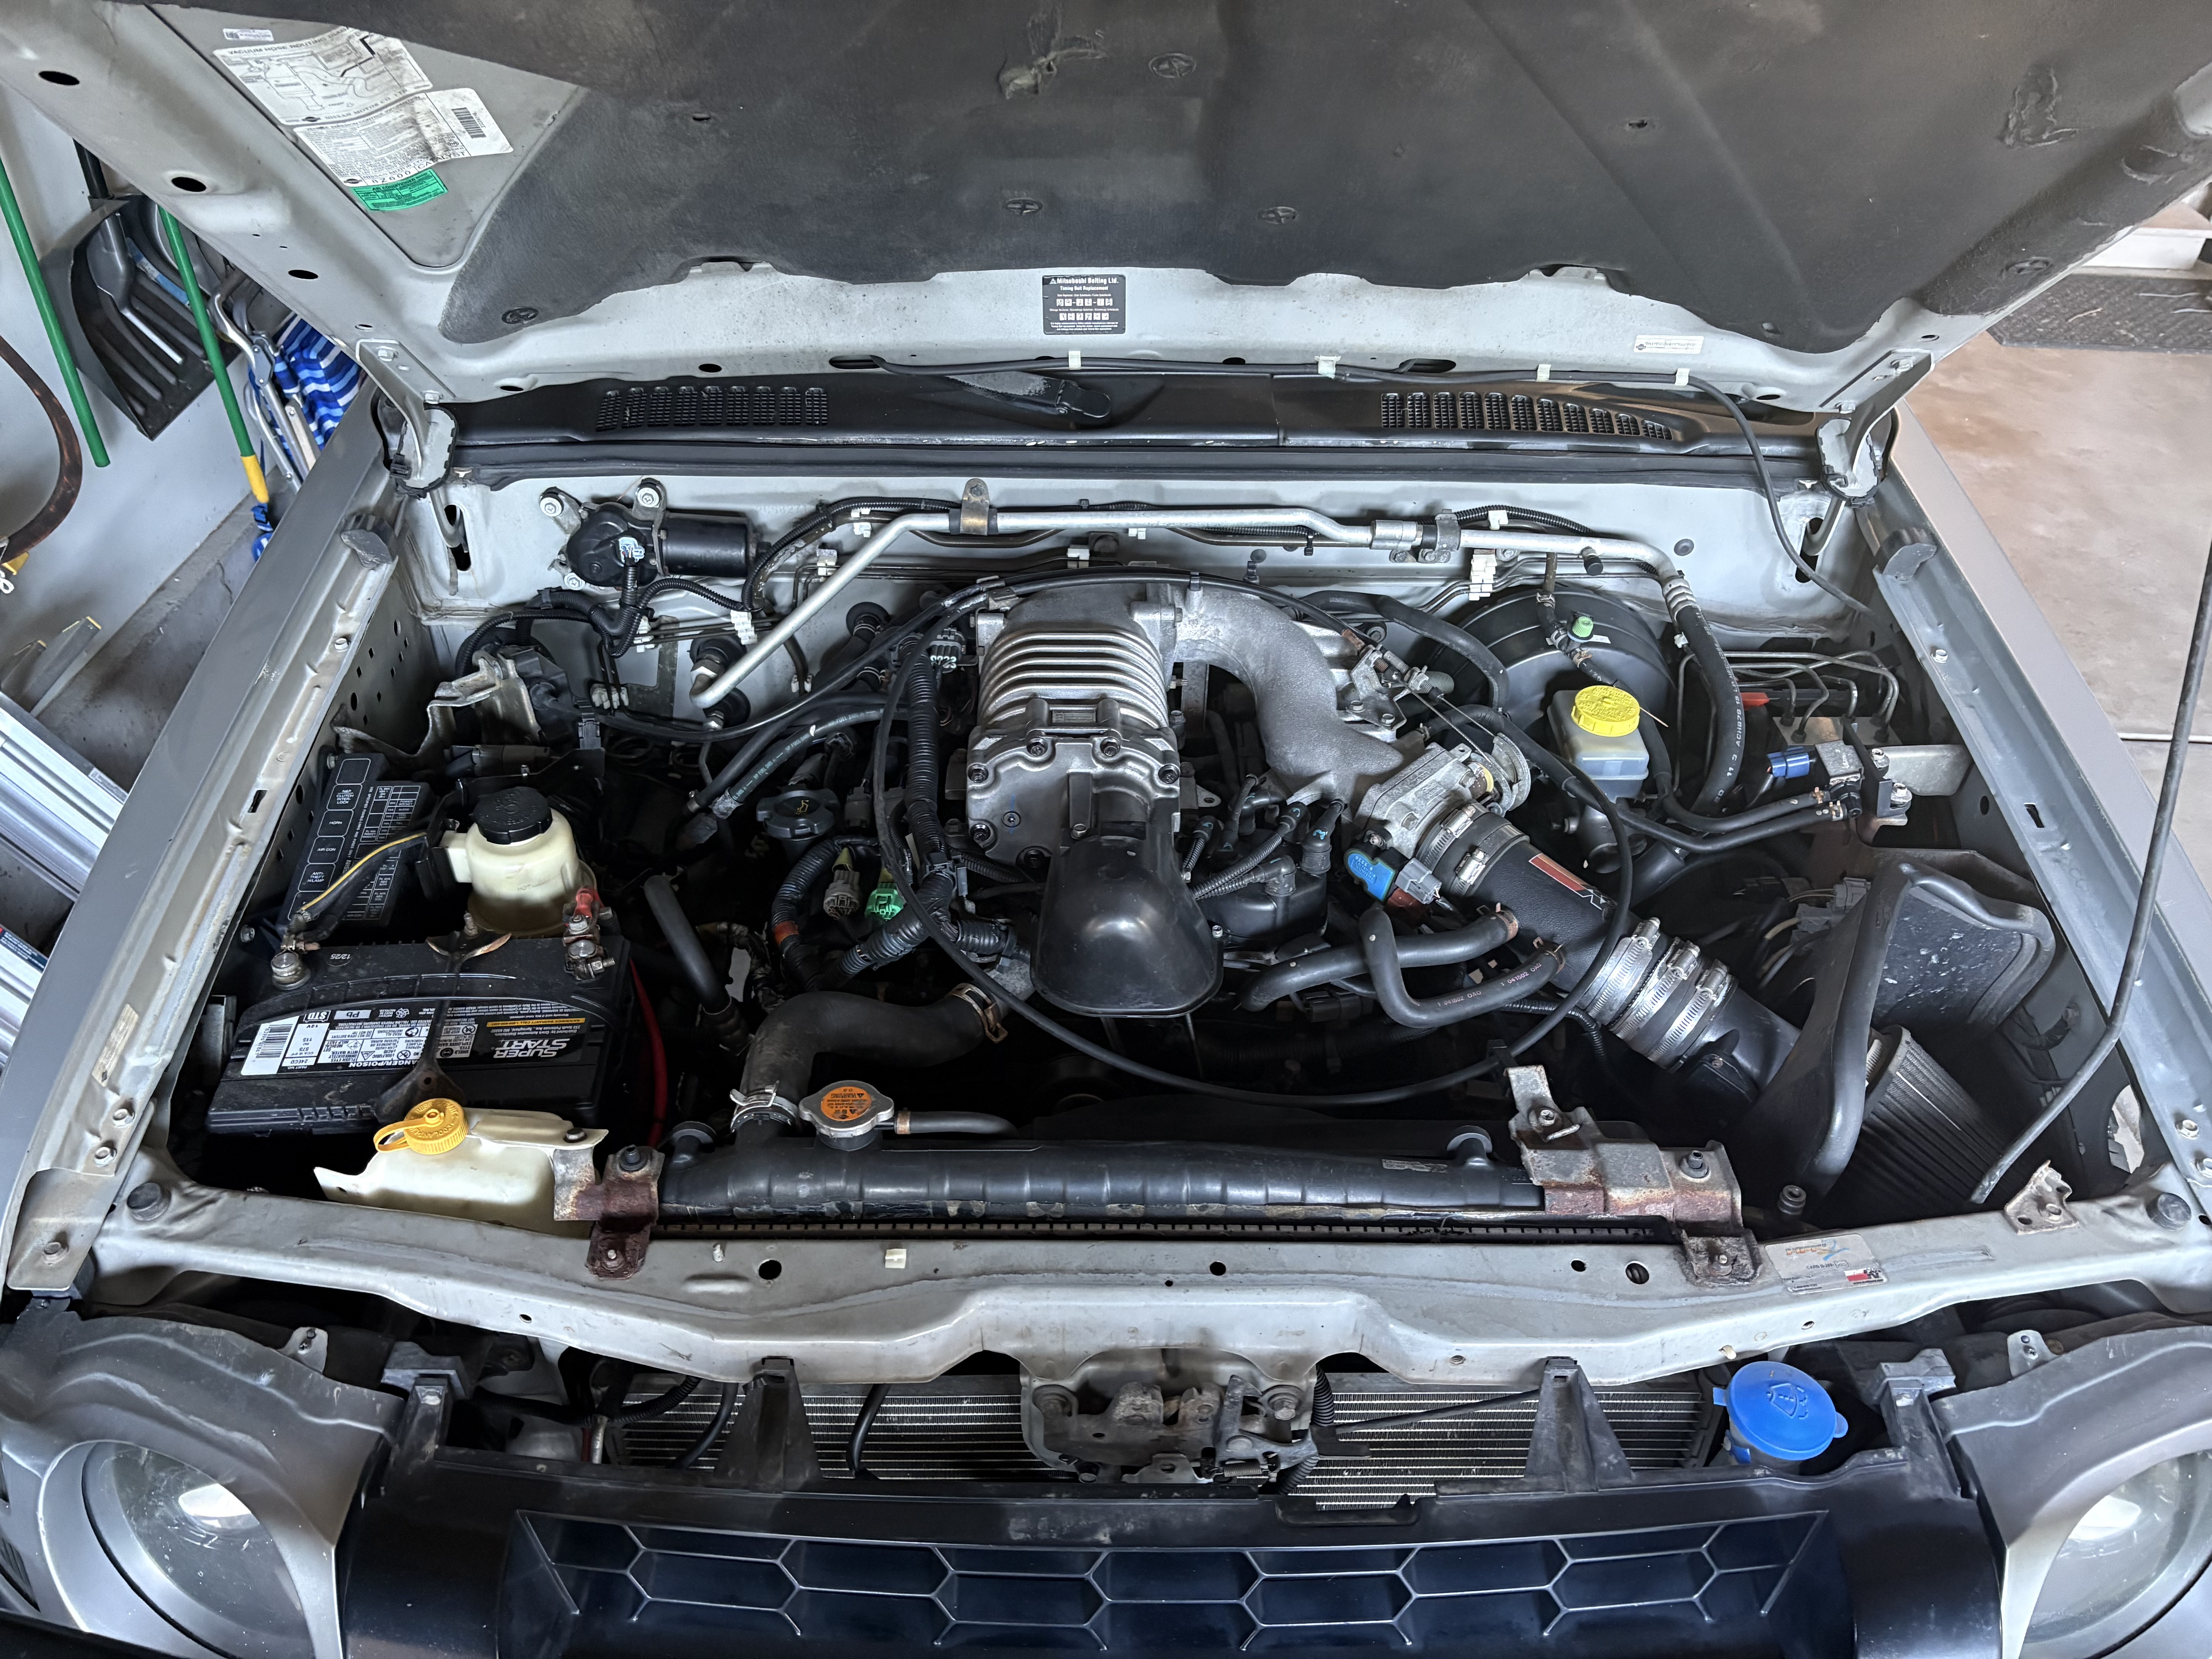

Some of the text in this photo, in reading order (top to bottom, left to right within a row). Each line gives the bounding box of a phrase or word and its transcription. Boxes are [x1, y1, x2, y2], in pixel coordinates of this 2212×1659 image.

[227, 37, 327, 57] VACUUM HOSE ROUTING
[325, 103, 380, 121] NISSAN MOTOR
[414, 150, 467, 169] CATALYST
[757, 766, 767, 775] FUEL
[790, 738, 801, 747] FUEL
[1507, 969, 1529, 986] 041502
[1443, 995, 1465, 1006] 041502
[307, 1011, 328, 1020] STD
[492, 1046, 559, 1061] SUPER
[493, 1036, 571, 1054] START
[347, 1058, 419, 1068] ANGER/POISON
